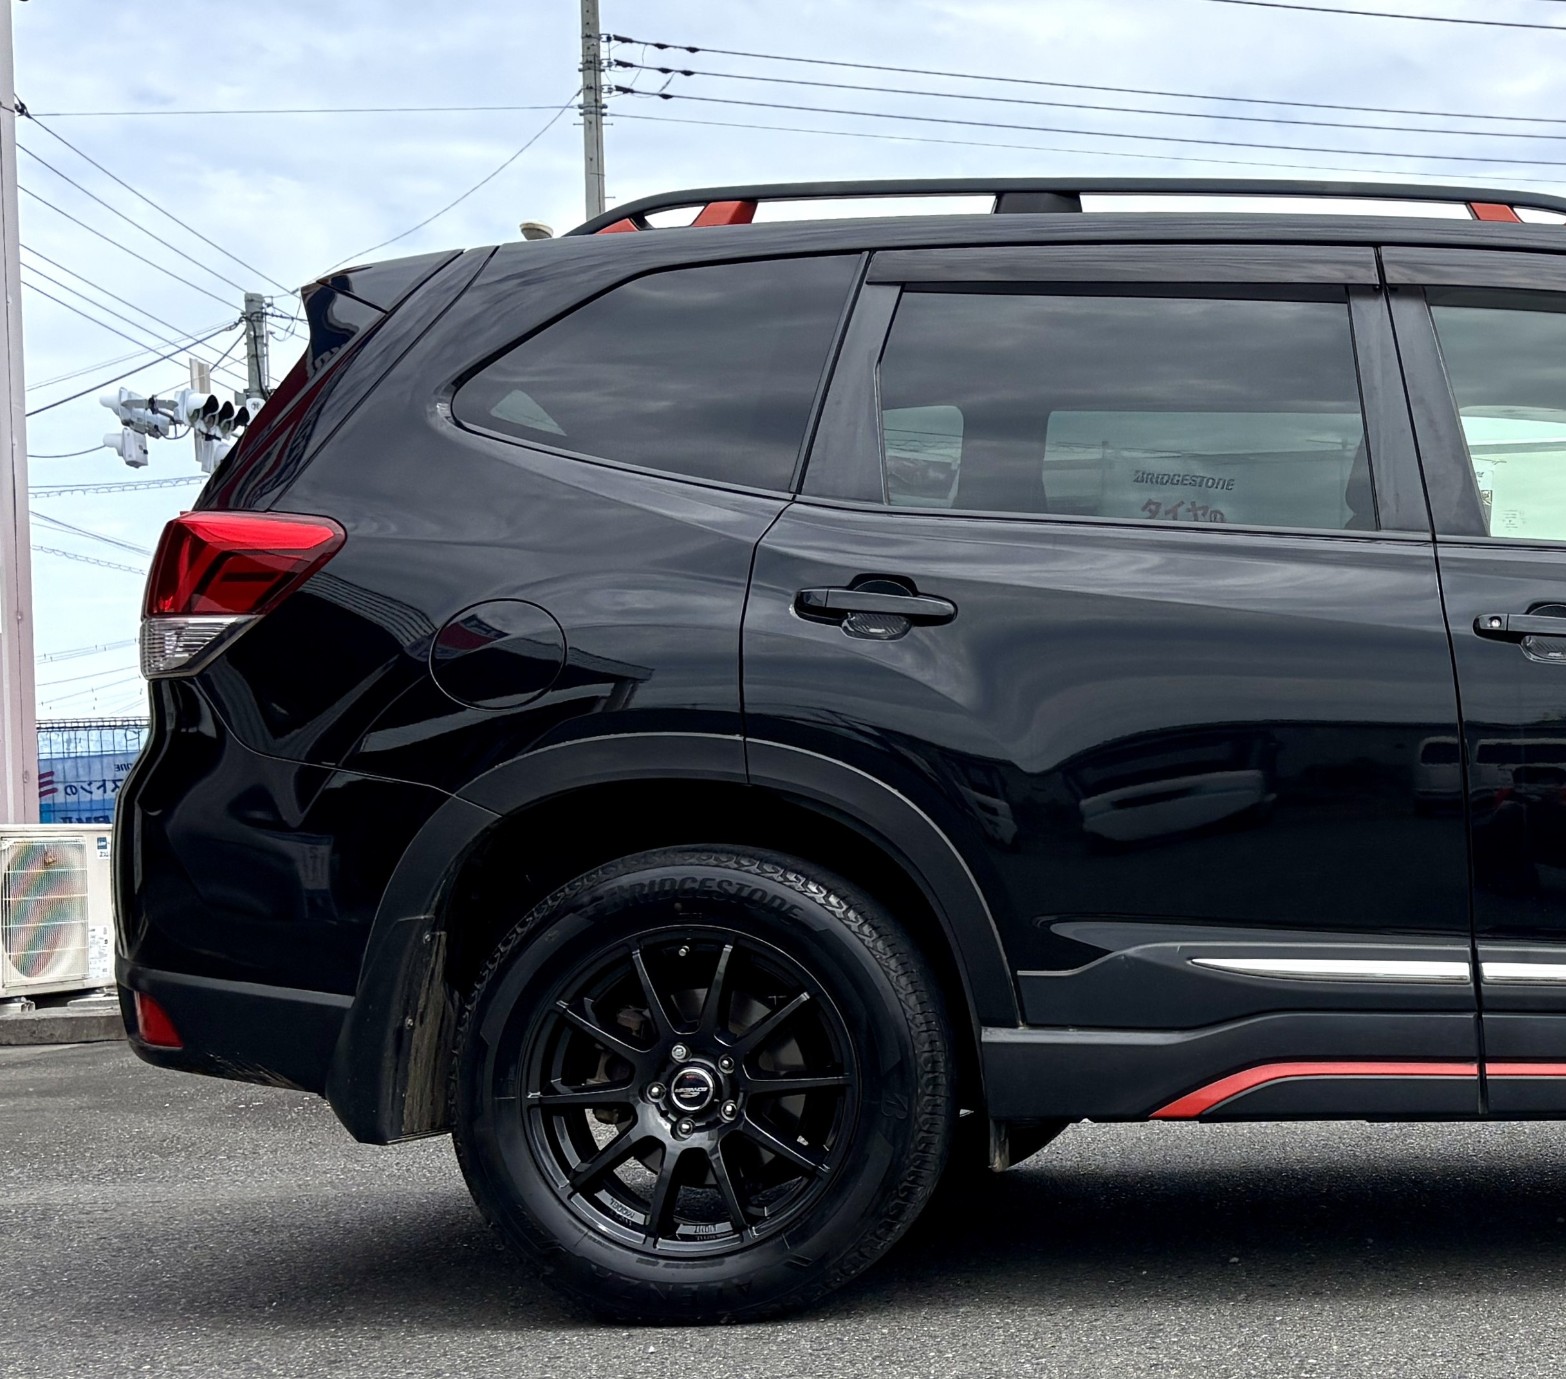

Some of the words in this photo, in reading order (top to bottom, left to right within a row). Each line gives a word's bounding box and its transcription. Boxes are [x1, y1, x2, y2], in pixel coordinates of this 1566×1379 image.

[1132, 469, 1235, 491] BRIDGESTONE
[1140, 498, 1226, 523] タイヤの
